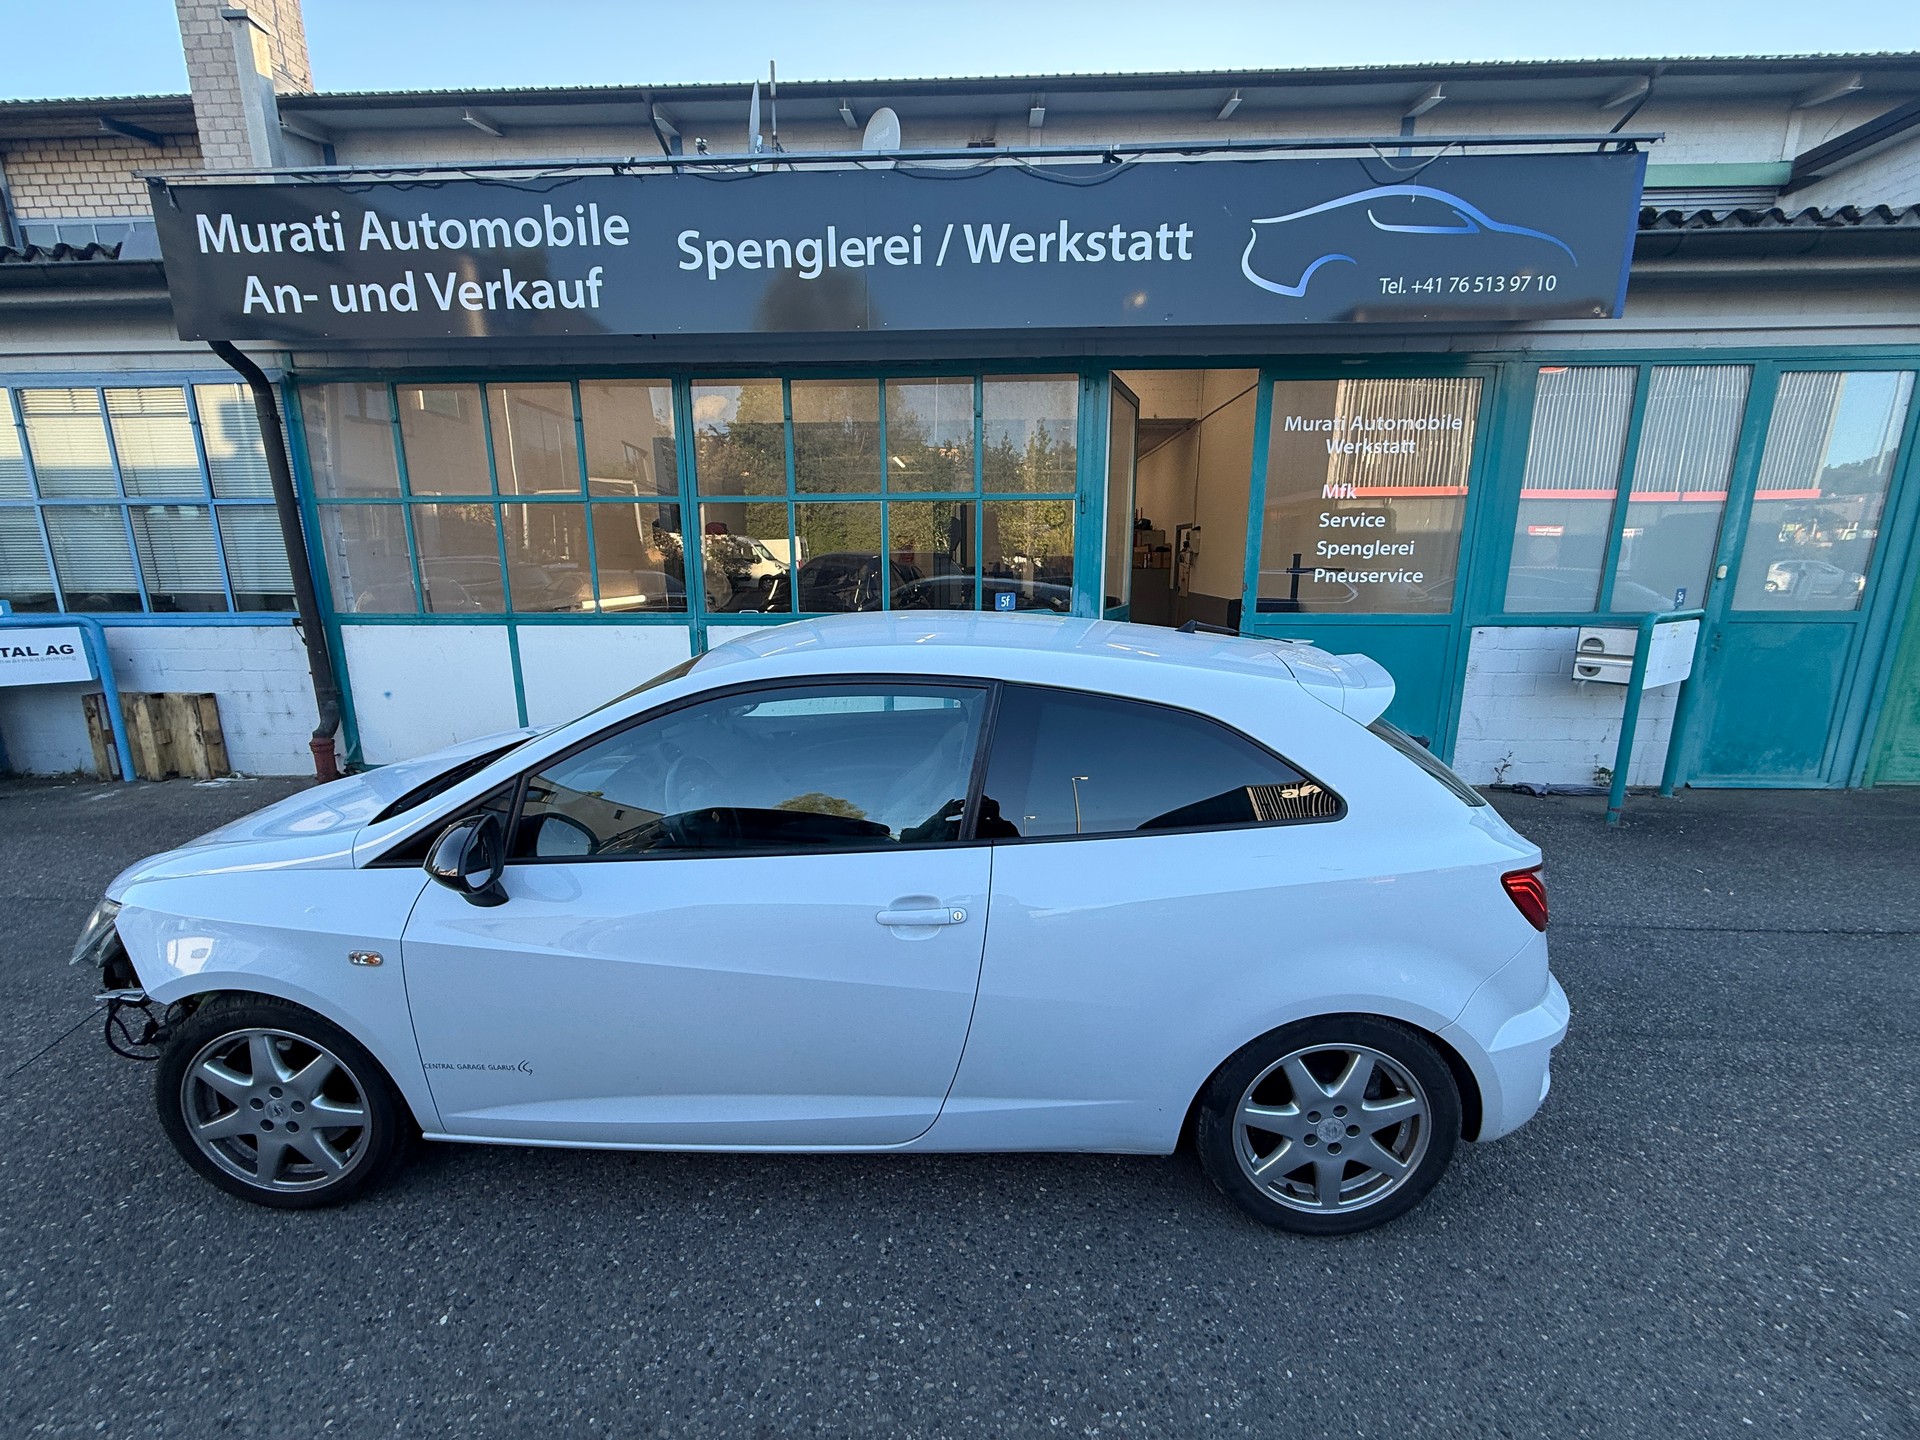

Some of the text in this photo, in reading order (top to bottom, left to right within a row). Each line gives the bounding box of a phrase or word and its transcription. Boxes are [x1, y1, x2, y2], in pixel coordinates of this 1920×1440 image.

[195, 202, 630, 254] Murati Automobile
[676, 219, 1194, 281] Spenglerei / Werkstatt
[242, 266, 603, 315] An- und Verkauf
[1379, 275, 1558, 294] Tel. +41 76 513 97 10
[1284, 413, 1463, 432] Murati Automobile
[1325, 438, 1417, 455] Werkstatt
[1321, 483, 1358, 500] Mfk
[1318, 512, 1386, 528] Service
[1316, 539, 1416, 560] Spenglerei
[1313, 566, 1424, 583] Pneuservice
[1000, 595, 1010, 607] 5f
[46, 644, 74, 655] AG
[456, 1063, 486, 1071] GARAGE
